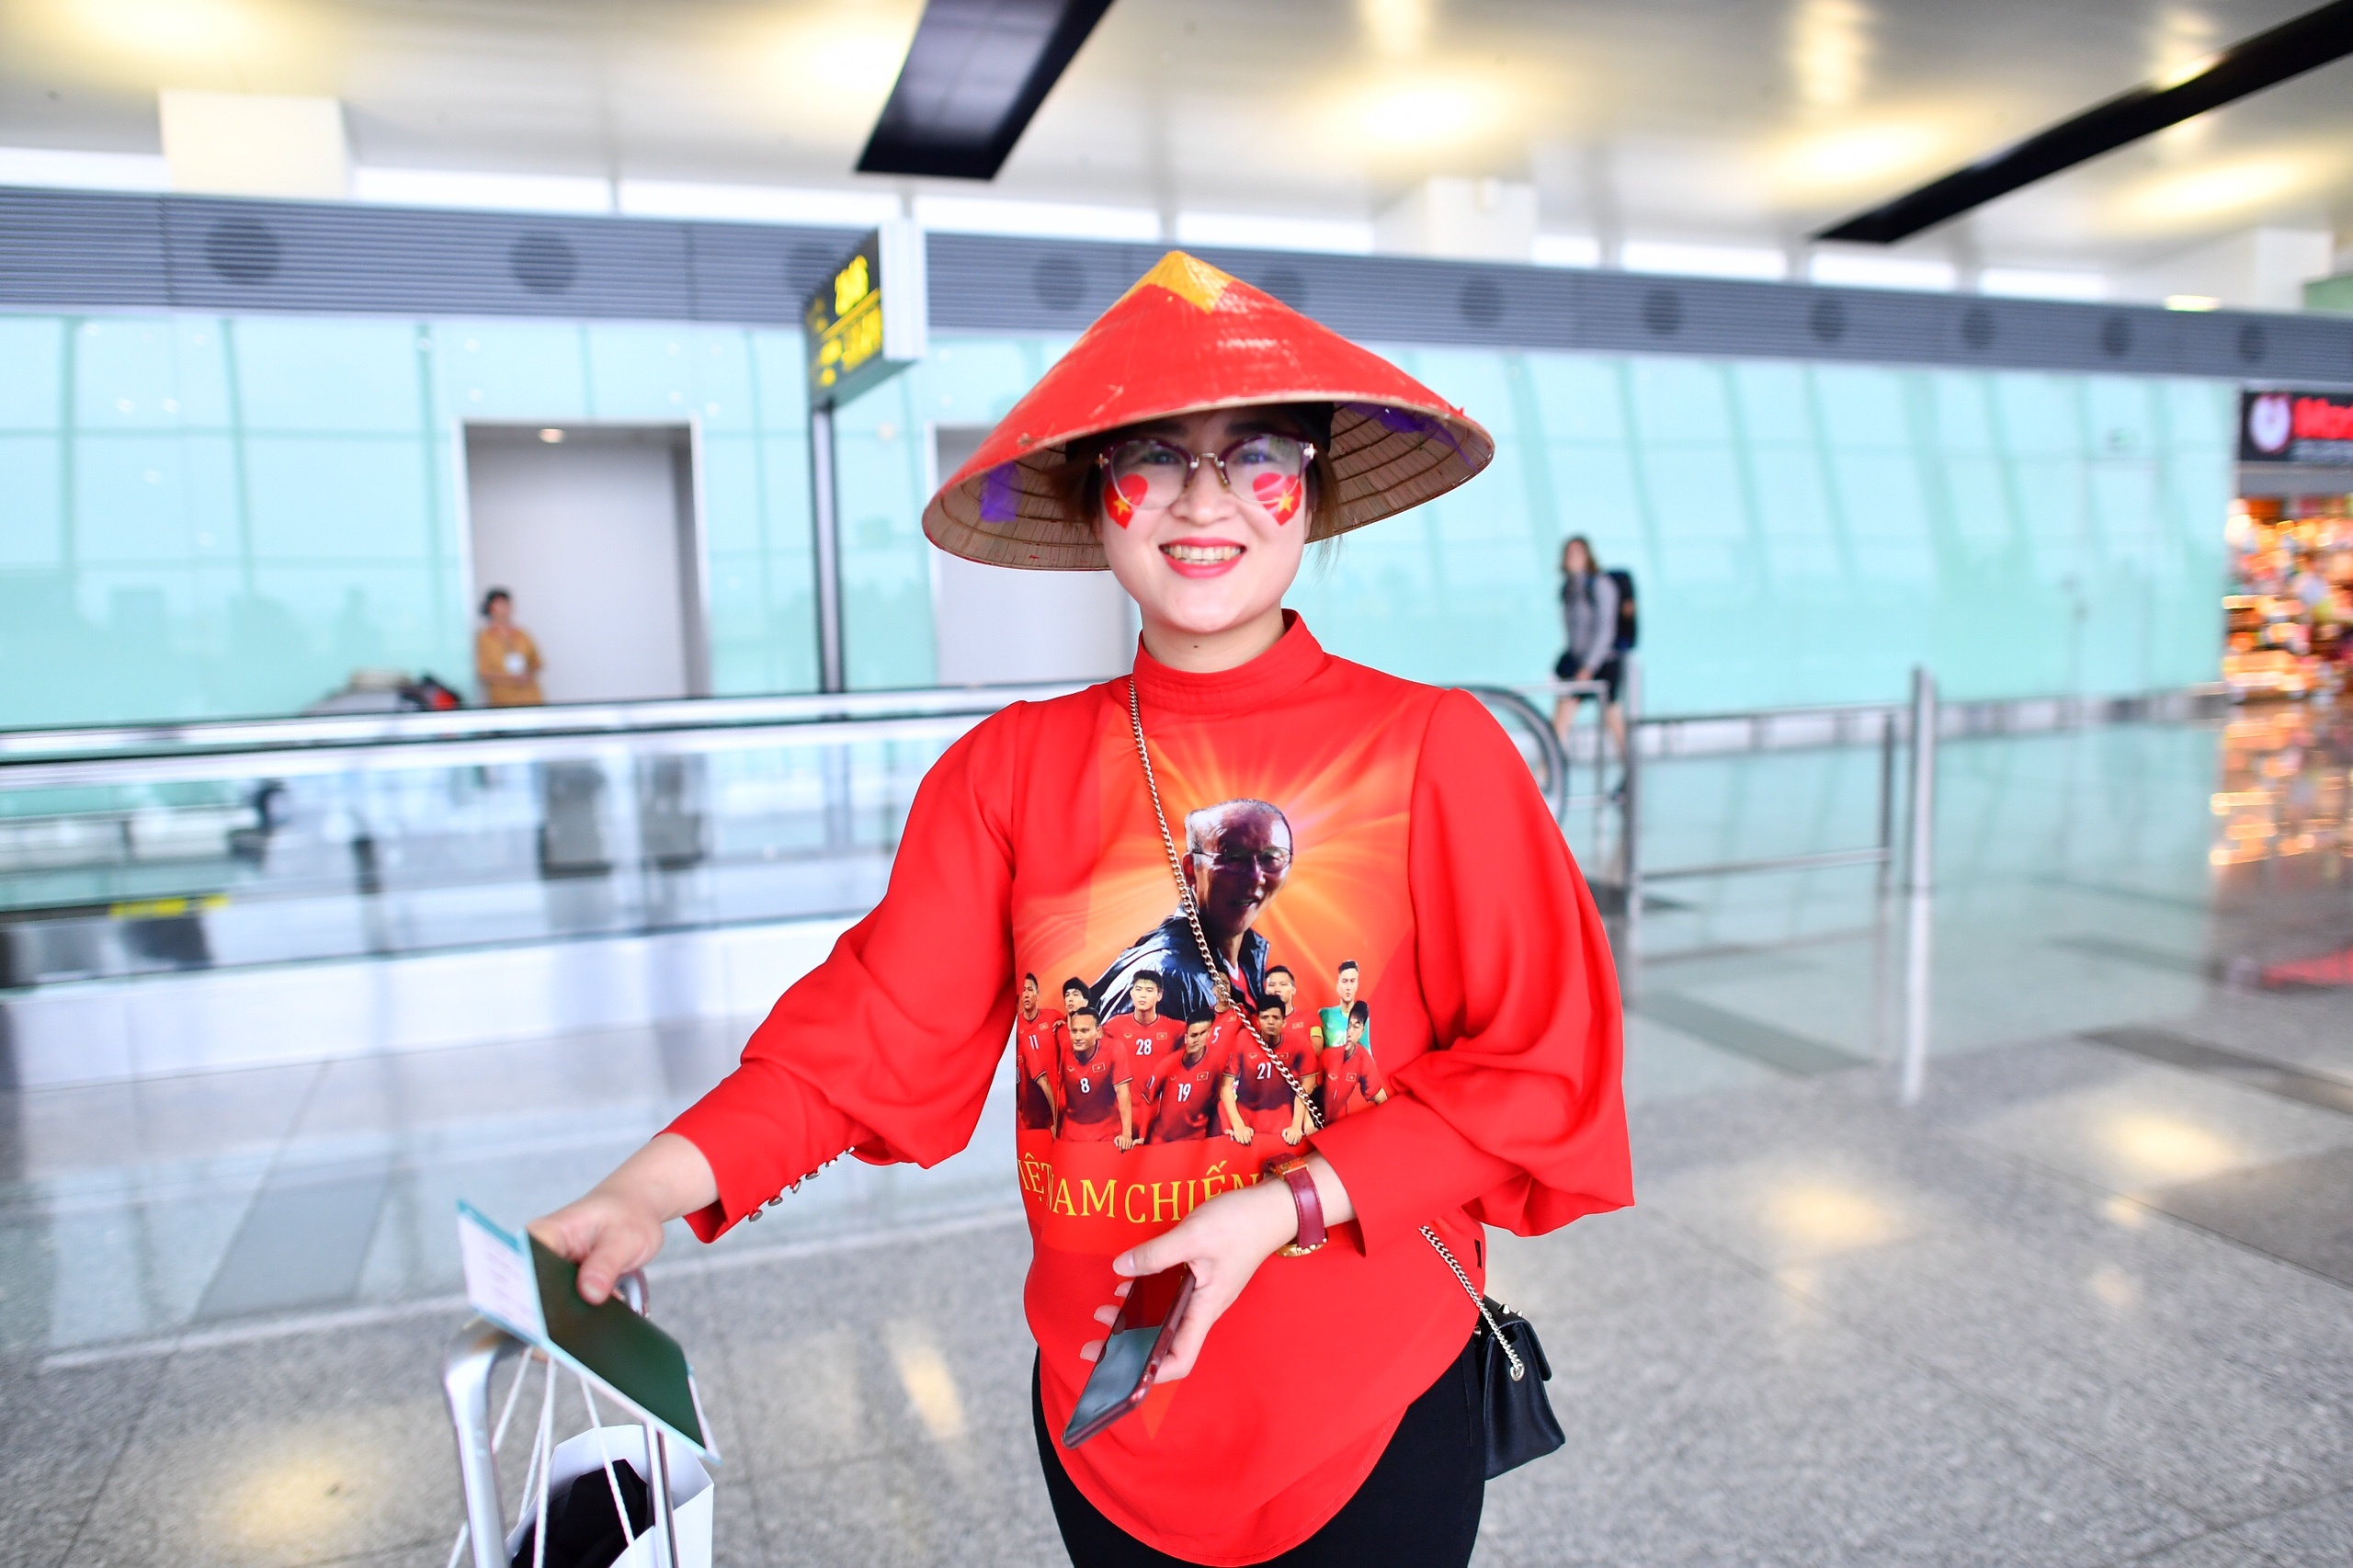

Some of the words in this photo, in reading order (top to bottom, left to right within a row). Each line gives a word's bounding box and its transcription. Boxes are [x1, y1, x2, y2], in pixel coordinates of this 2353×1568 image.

[1029, 1034, 1040, 1051] 11
[1136, 1039, 1153, 1056] 28
[1256, 1062, 1272, 1080] 21
[1080, 1077, 1090, 1094] 8
[1177, 1083, 1192, 1102] 19
